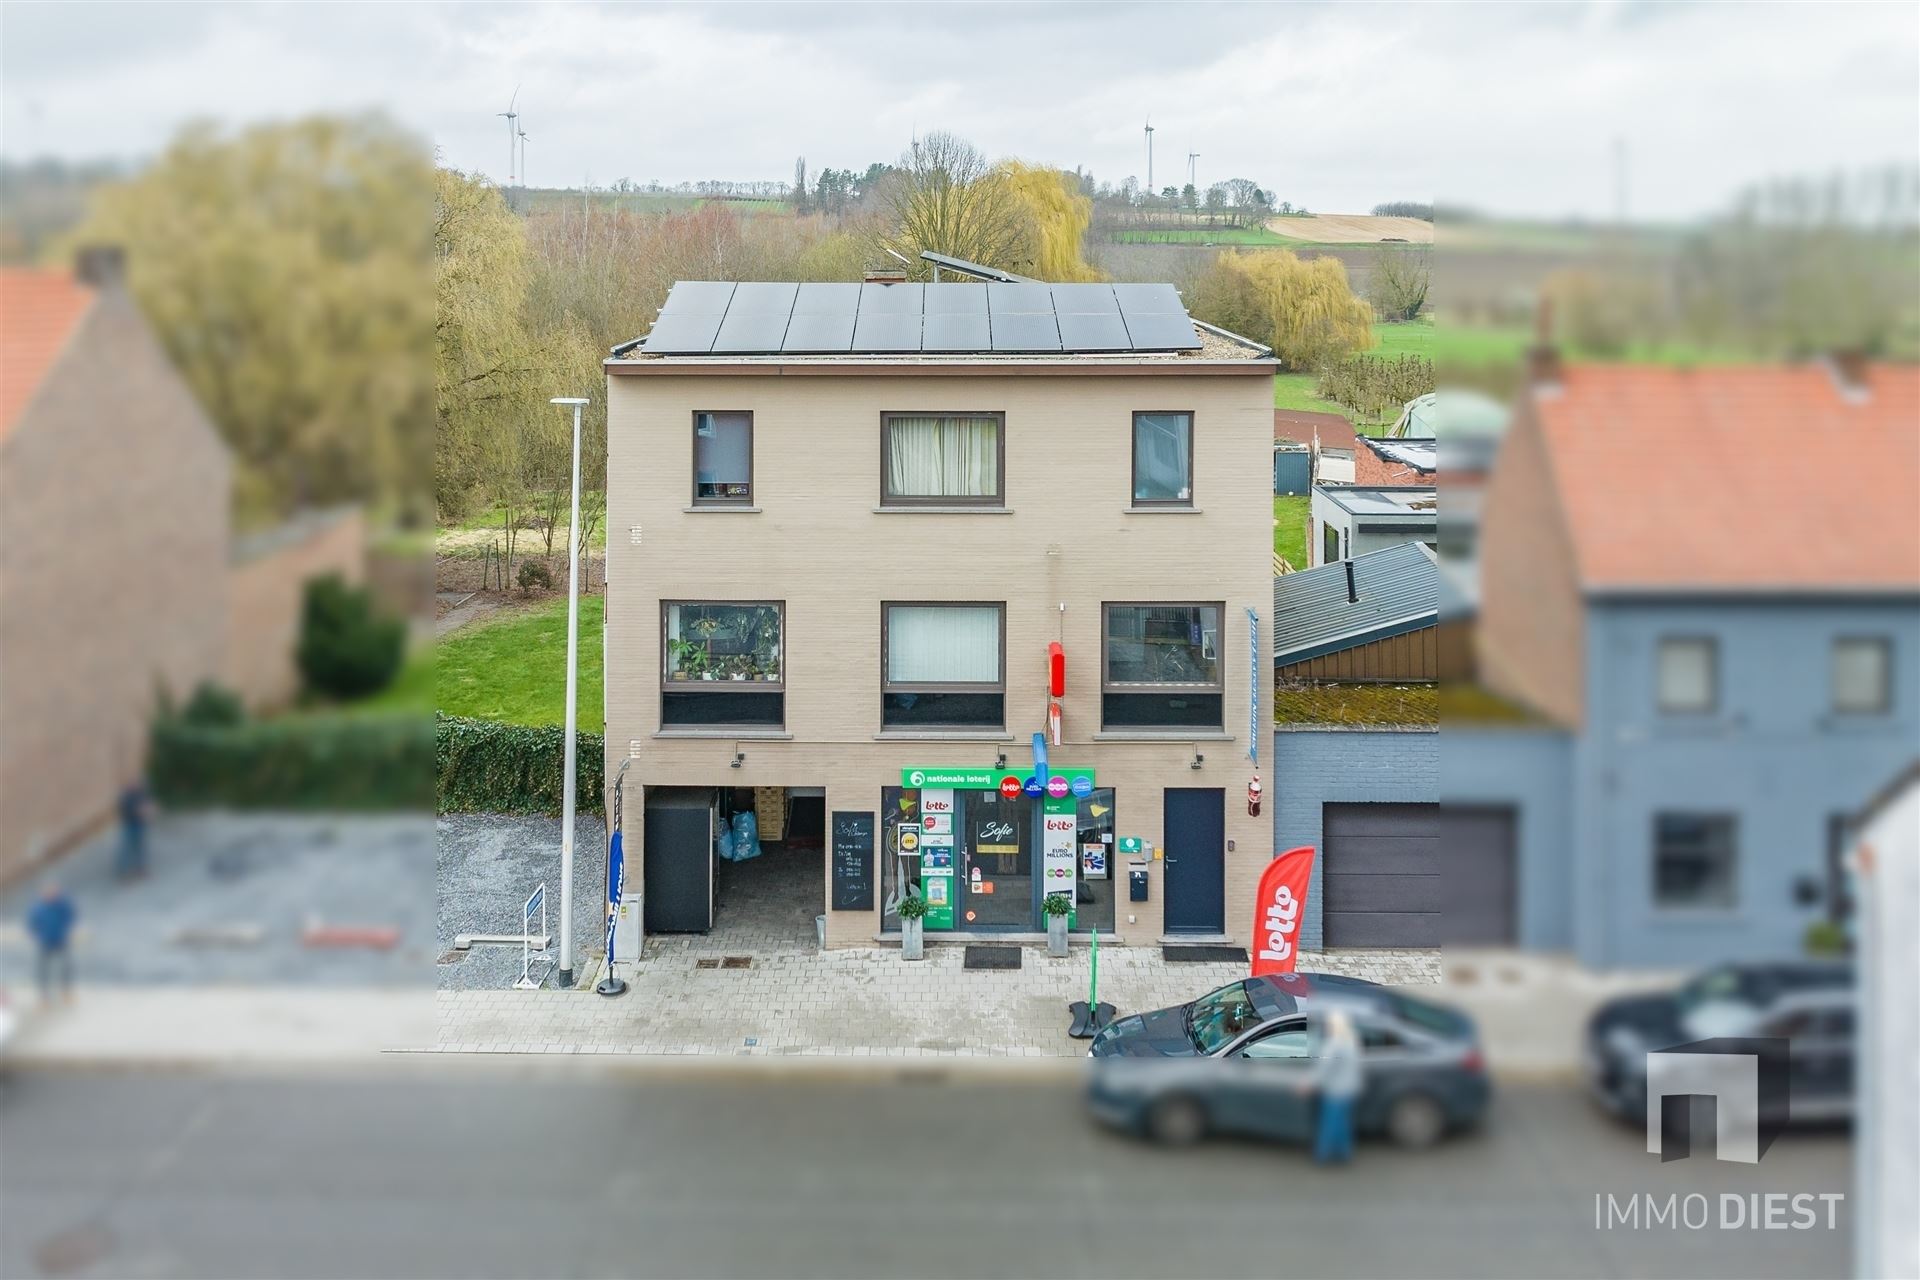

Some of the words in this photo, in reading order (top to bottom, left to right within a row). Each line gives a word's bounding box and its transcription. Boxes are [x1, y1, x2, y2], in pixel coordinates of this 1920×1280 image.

[926, 774, 965, 783] nationale
[966, 774, 991, 785] loterij
[980, 821, 1014, 842] Sofie
